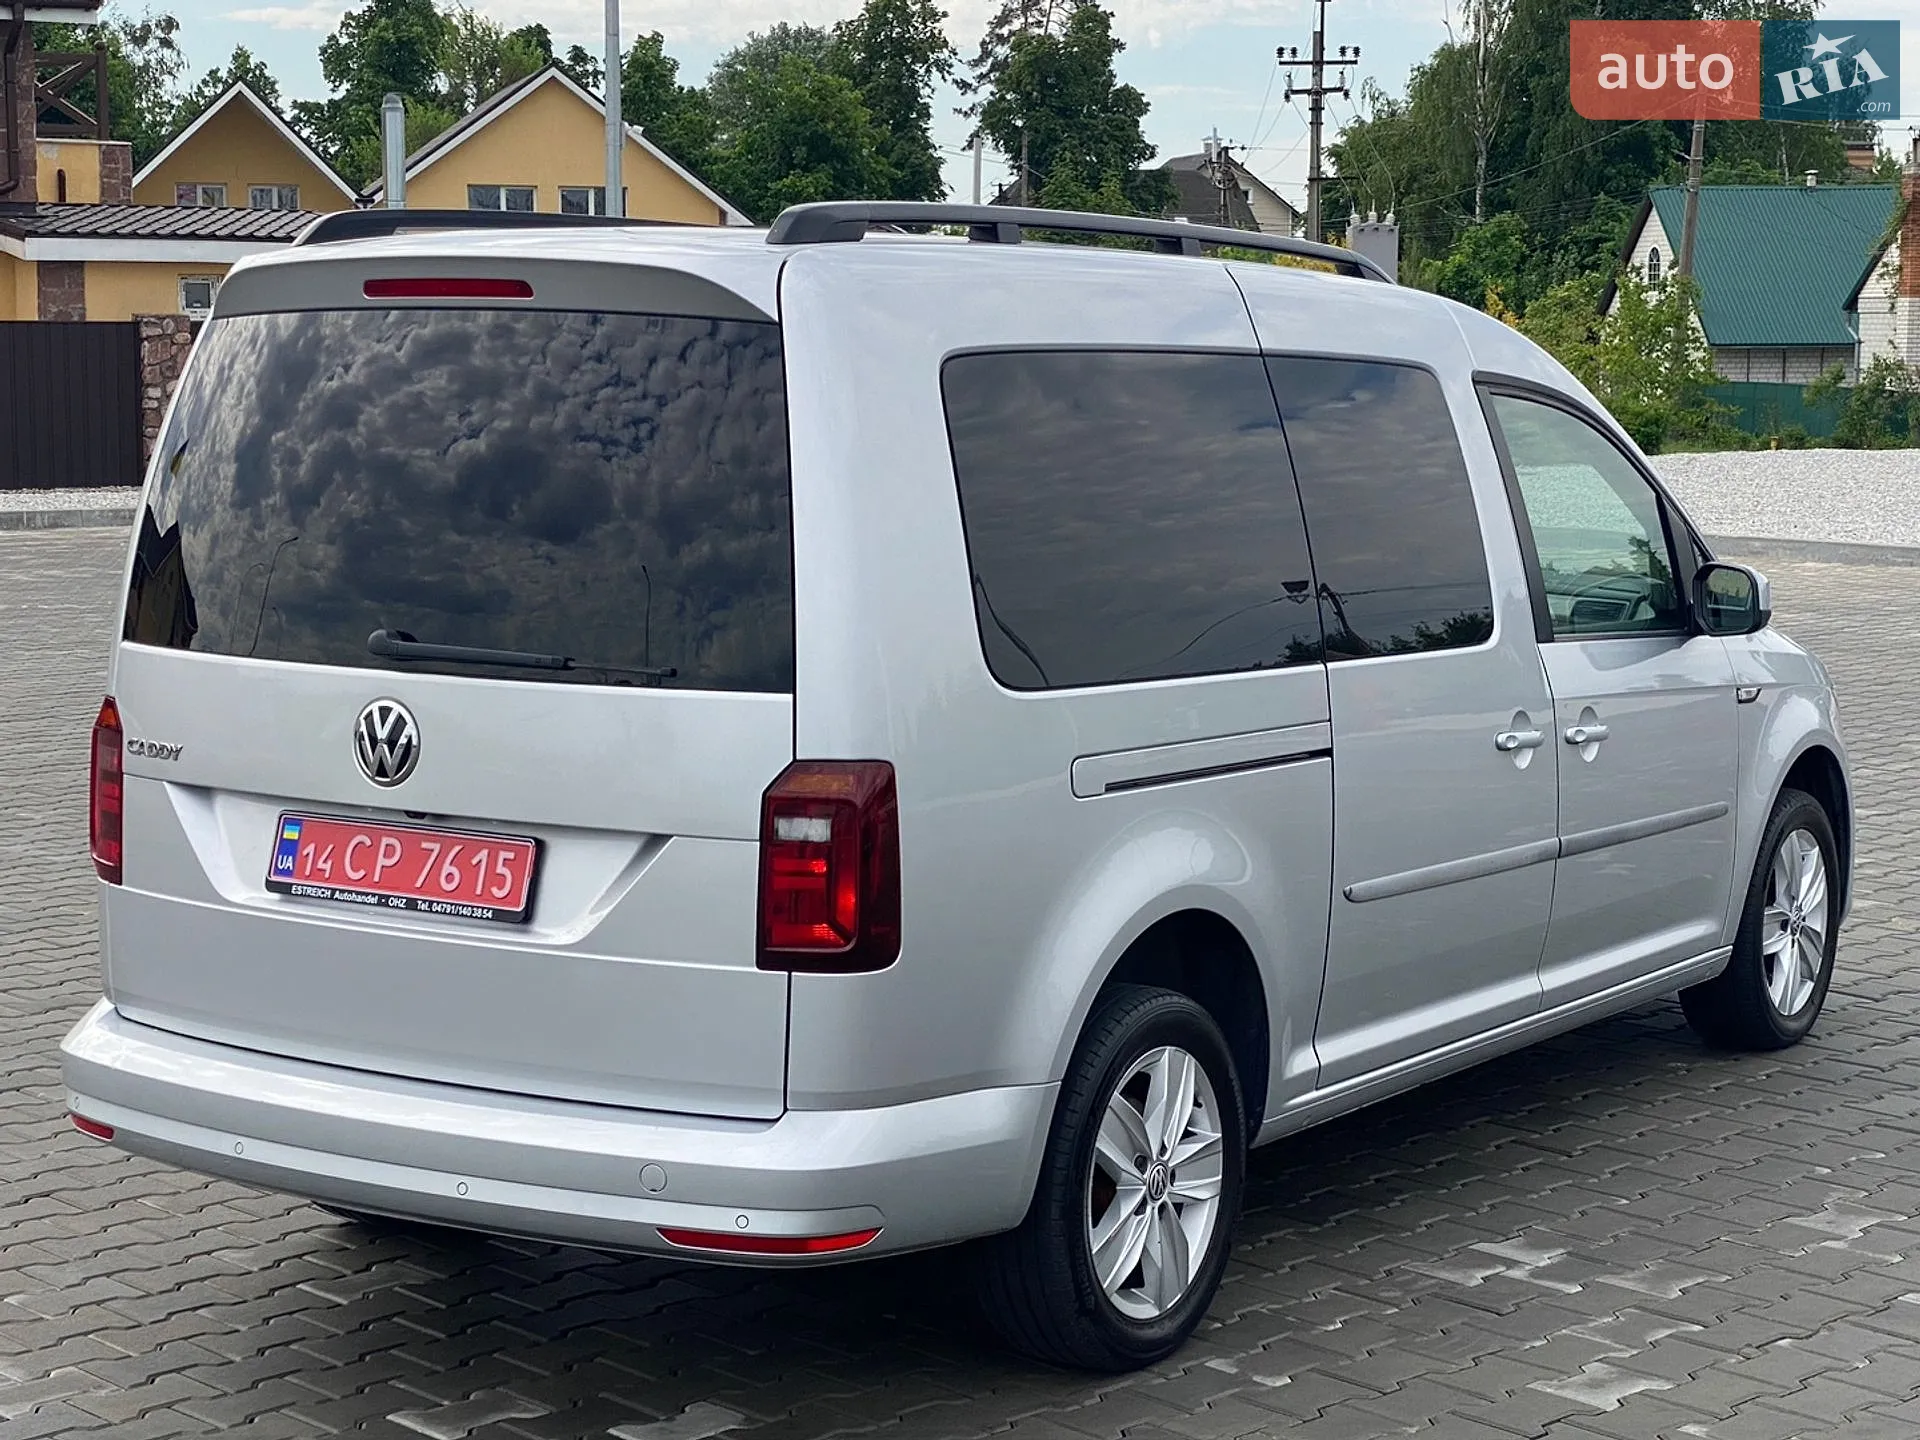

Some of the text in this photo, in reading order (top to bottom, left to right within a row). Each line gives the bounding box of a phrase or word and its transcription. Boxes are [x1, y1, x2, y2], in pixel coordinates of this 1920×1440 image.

[127, 737, 184, 761] CADDY
[278, 854, 294, 871] UA
[302, 834, 516, 899] 14 CP 7615
[291, 885, 331, 899] ESTREICH
[333, 890, 378, 904] Autohandel
[388, 897, 407, 908] OHZ
